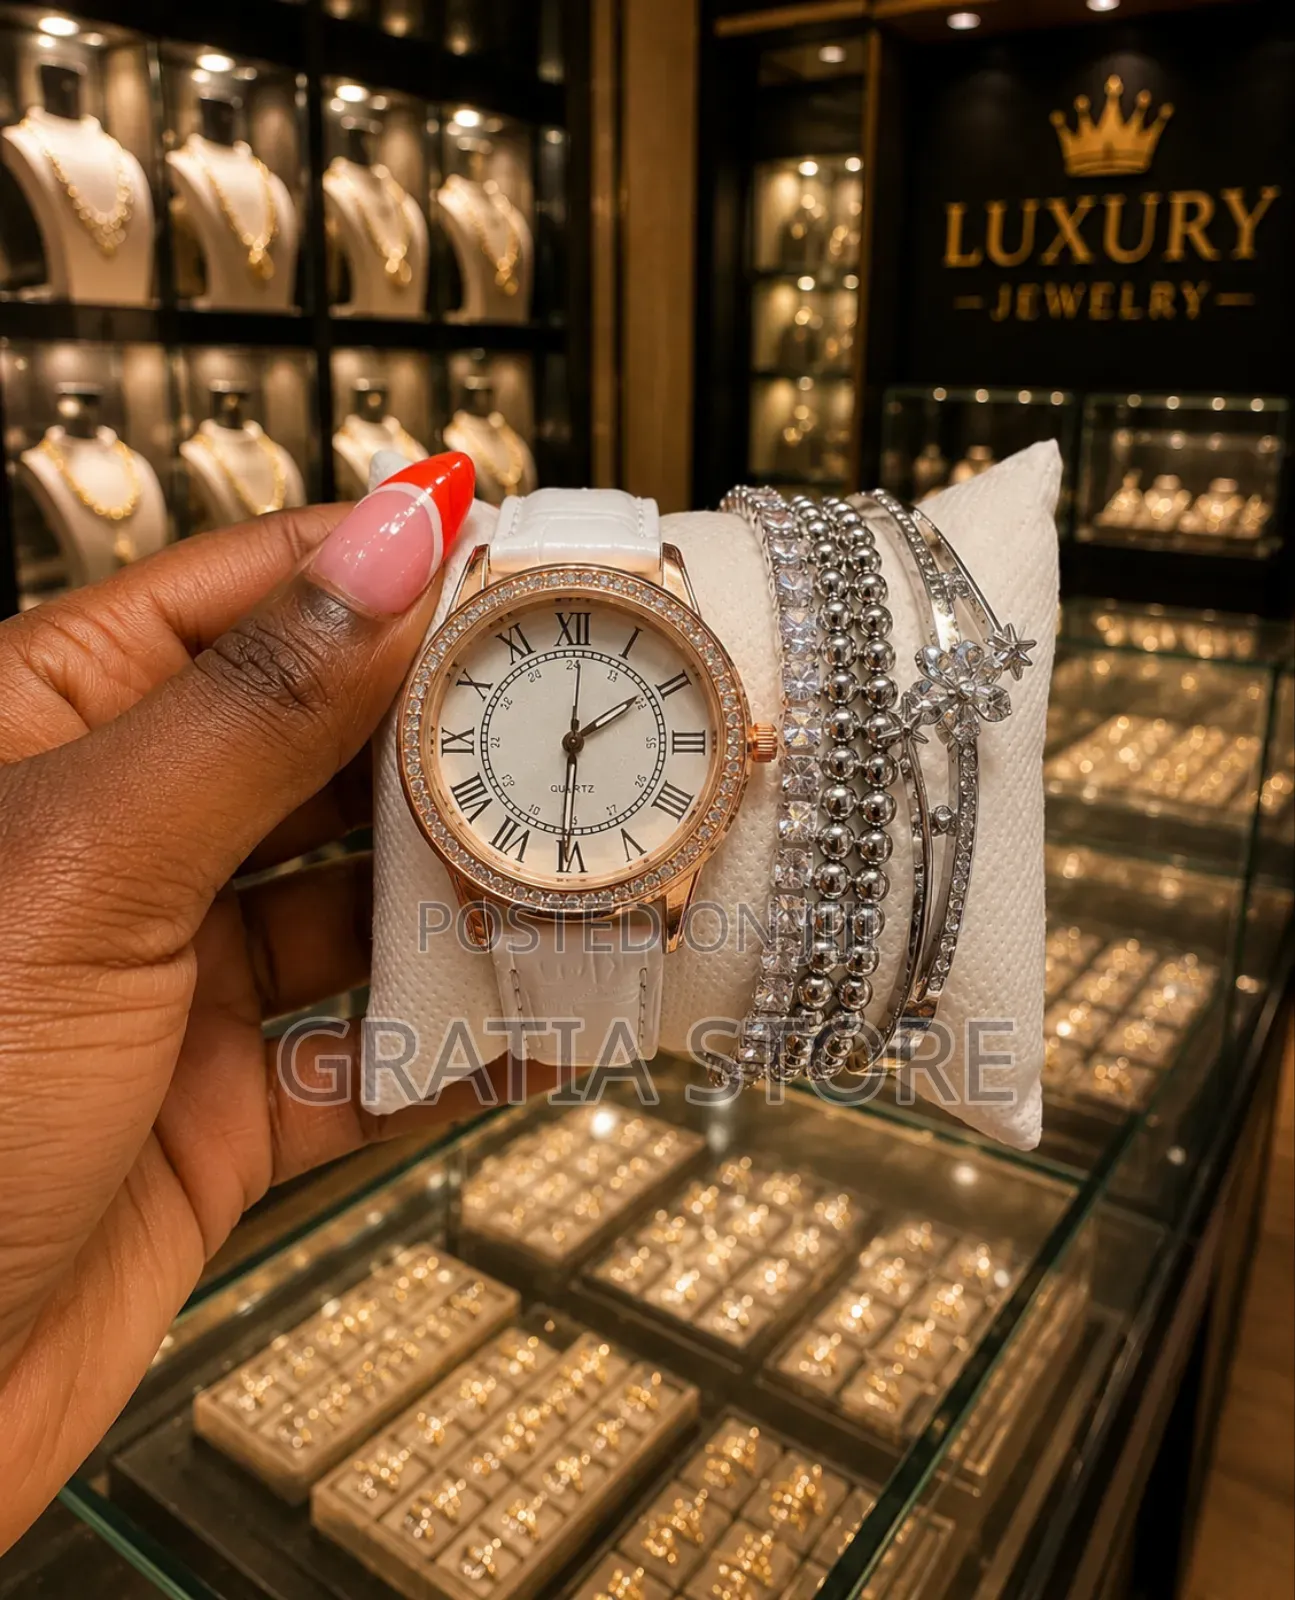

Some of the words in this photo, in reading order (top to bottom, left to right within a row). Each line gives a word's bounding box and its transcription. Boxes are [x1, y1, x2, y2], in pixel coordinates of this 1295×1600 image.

[943, 185, 1282, 268] LUXURY
[990, 280, 1211, 322] JEWELRY
[495, 622, 537, 667] XI
[553, 612, 592, 647] XII
[619, 626, 644, 661] I
[456, 668, 494, 702] X
[655, 669, 693, 702] II
[441, 726, 475, 757] IX
[672, 729, 706, 756] III
[450, 771, 494, 825] VIII
[489, 814, 531, 864] VII
[620, 828, 648, 863] V
